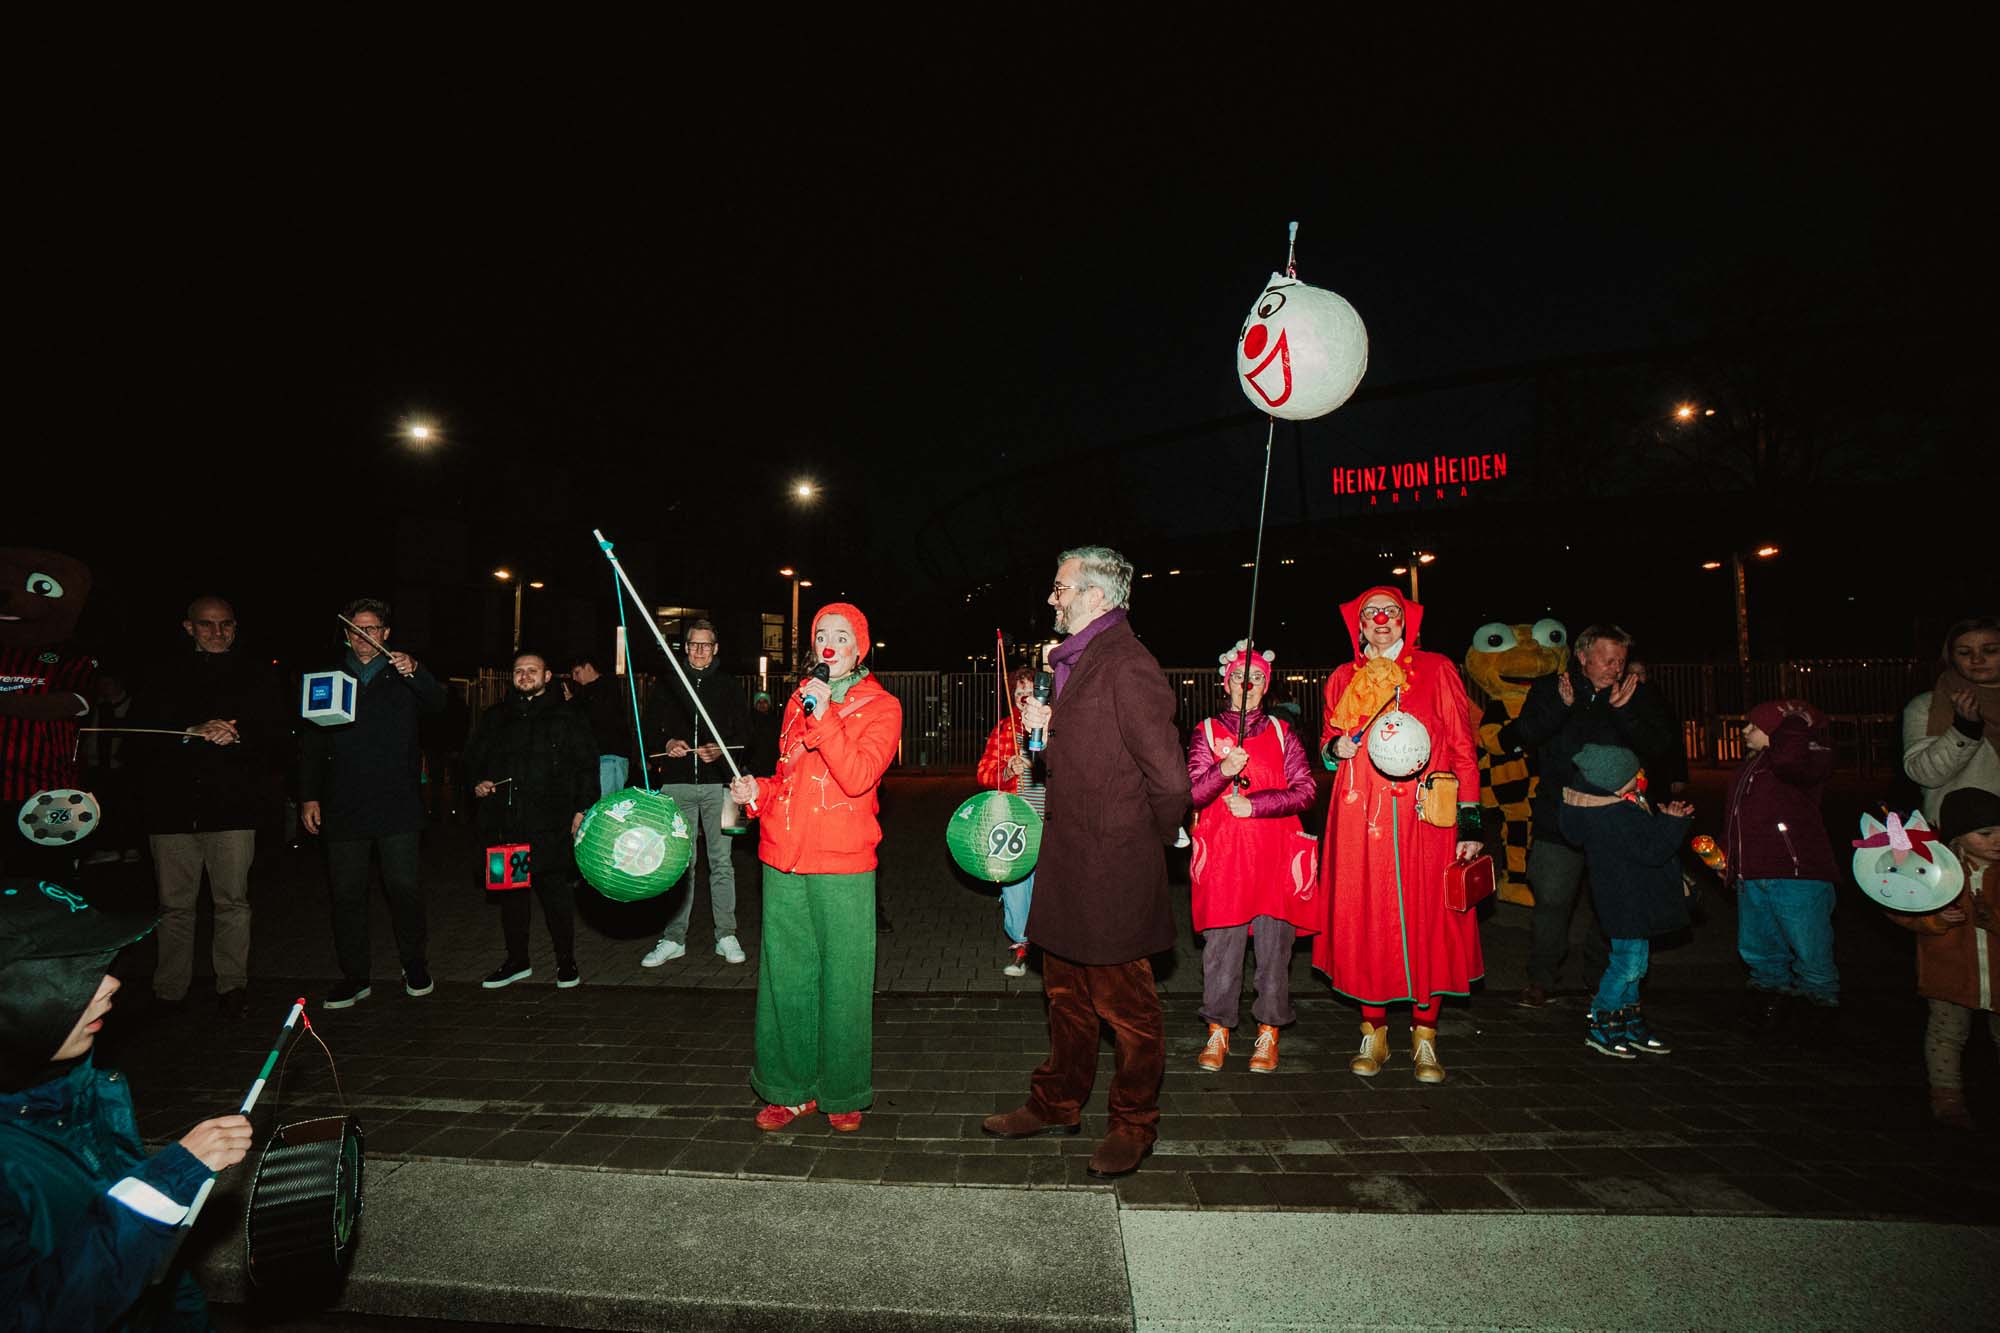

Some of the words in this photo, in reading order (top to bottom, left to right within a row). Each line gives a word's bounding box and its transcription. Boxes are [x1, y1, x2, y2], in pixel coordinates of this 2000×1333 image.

[1333, 465, 1388, 495] HEINZ
[1391, 461, 1429, 489] VON
[1434, 452, 1508, 485] HEIDEN
[1370, 485, 1468, 505] ARENA
[49, 809, 69, 824] 96
[991, 827, 1023, 855] 96
[510, 851, 530, 877] 96
